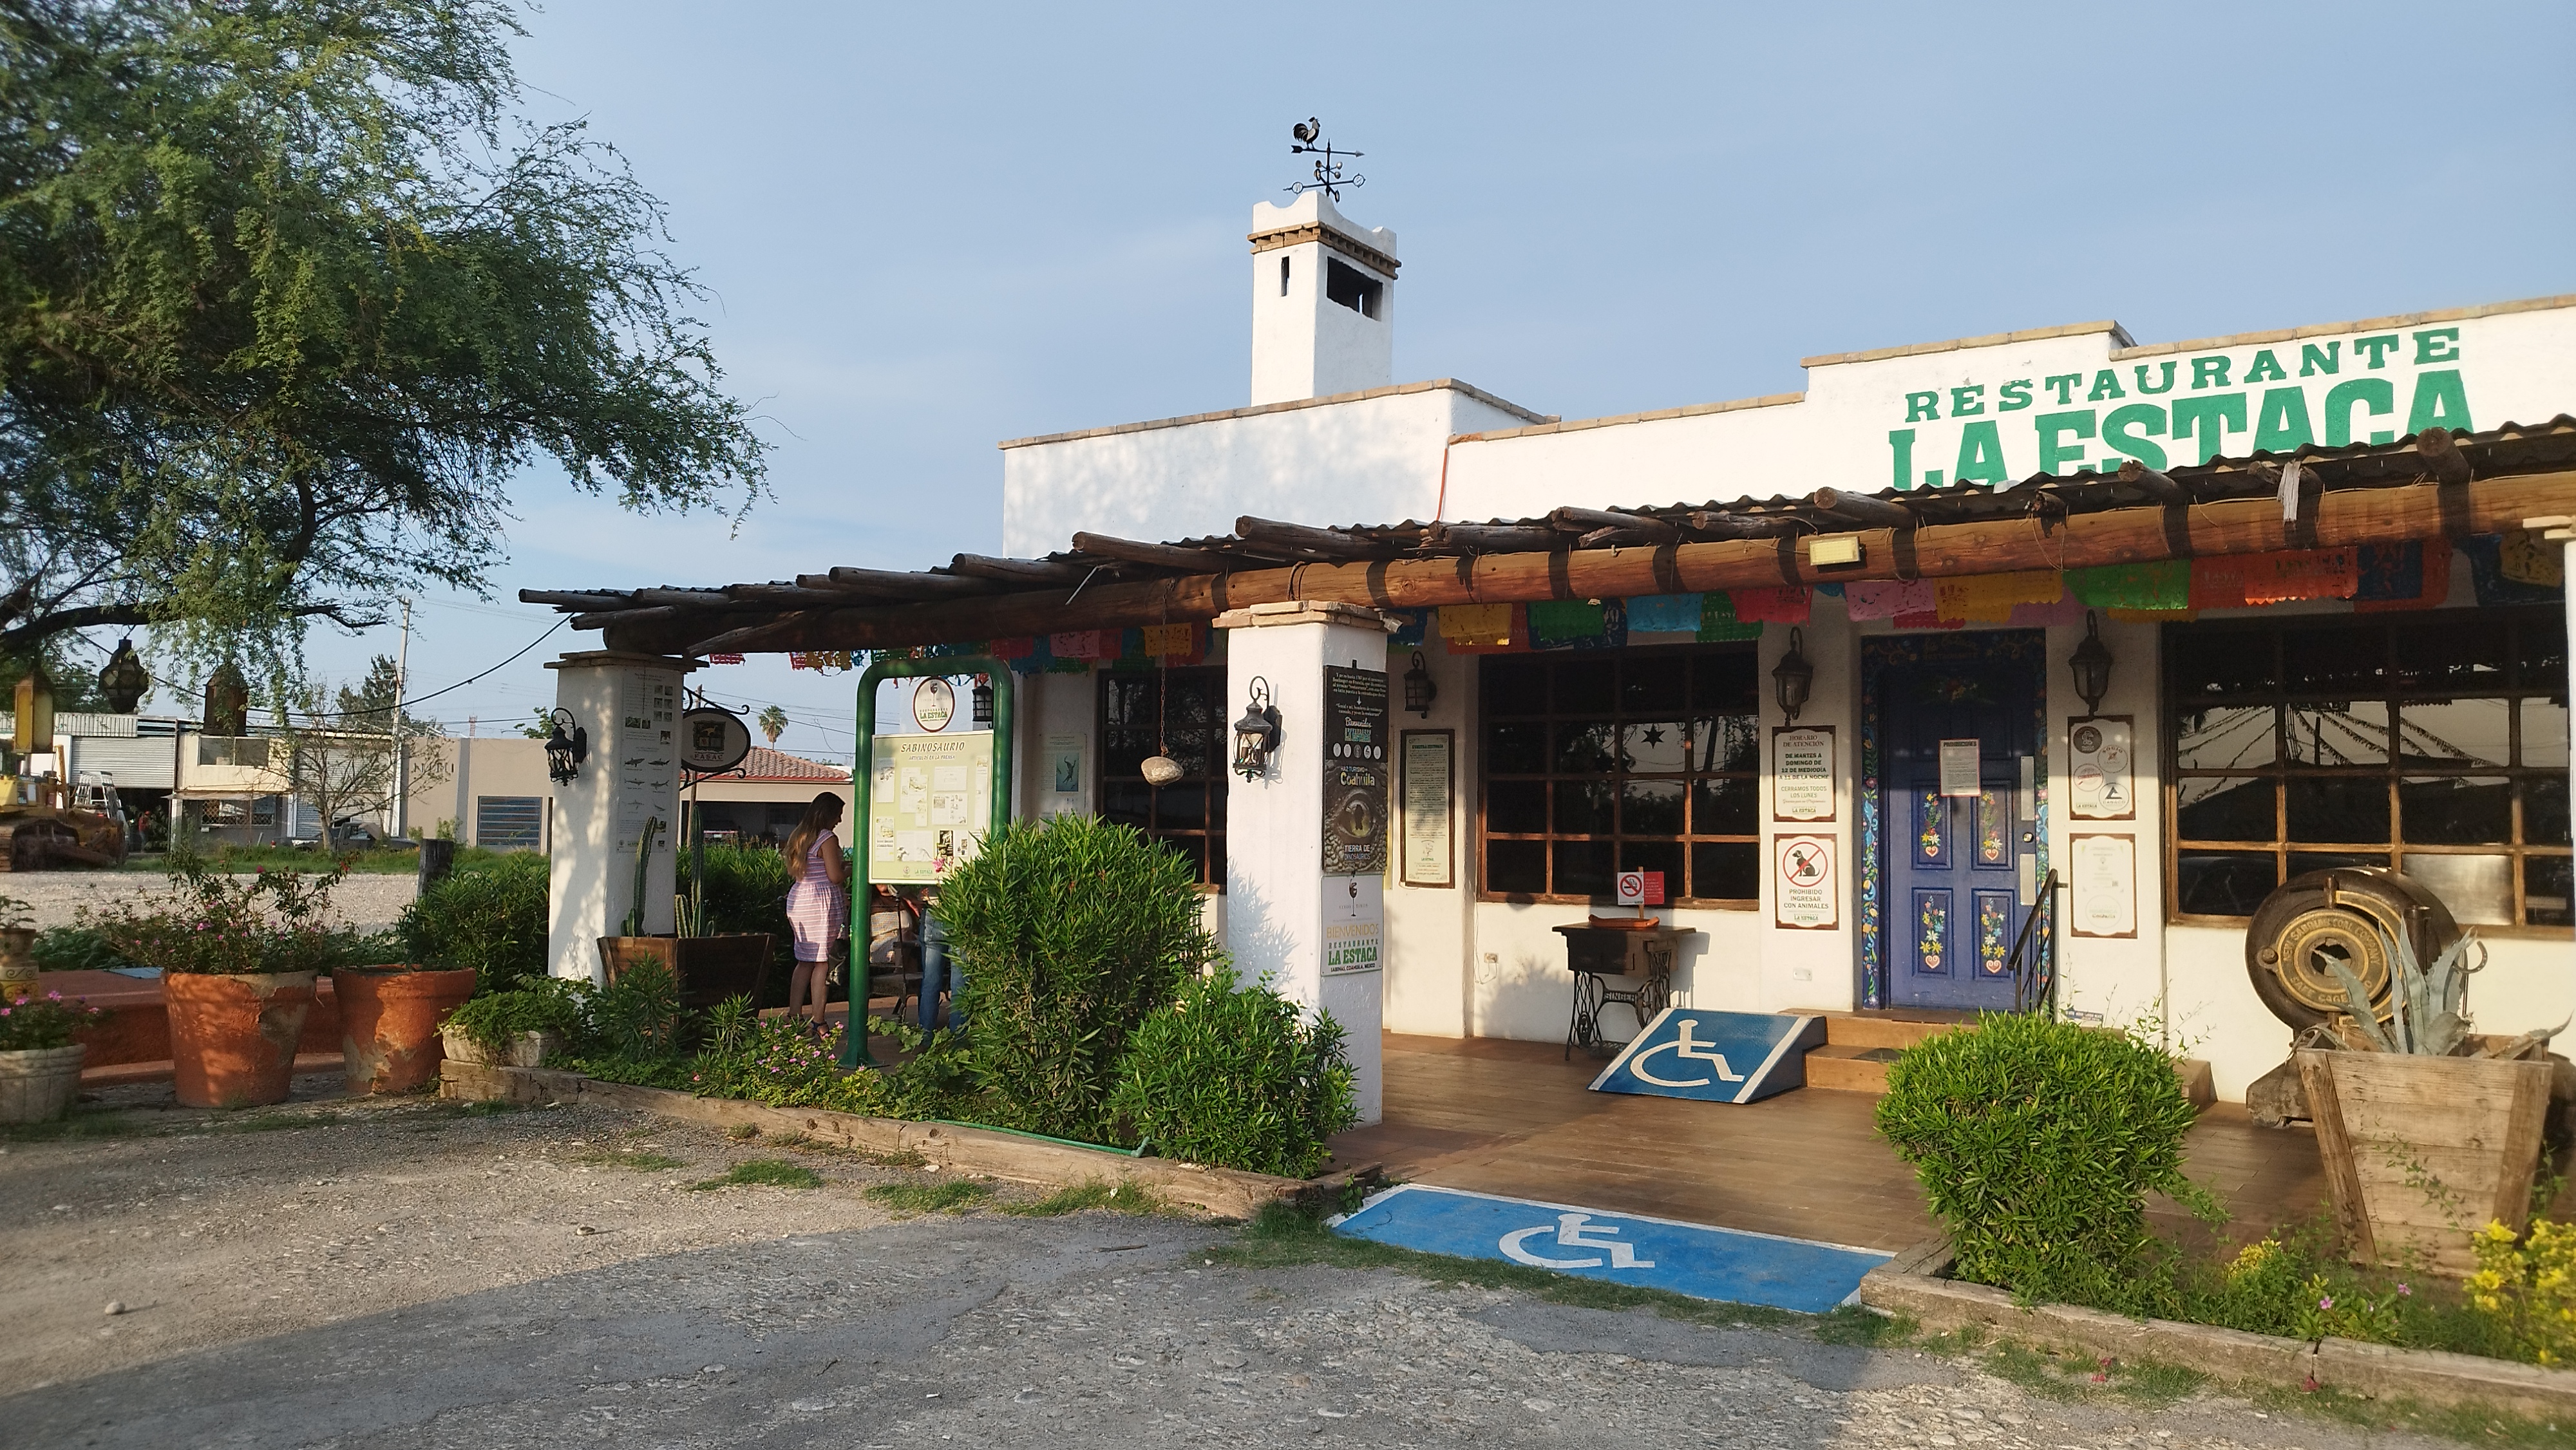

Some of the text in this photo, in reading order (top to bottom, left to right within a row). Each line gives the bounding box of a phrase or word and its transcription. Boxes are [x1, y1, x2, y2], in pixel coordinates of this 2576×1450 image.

[1904, 327, 2460, 422] RESTAURANTE
[1888, 370, 2474, 491] LA ESTACA
[900, 742, 965, 753] SABINOSAURIO
[1340, 772, 1375, 786] Coahuila
[1327, 923, 1379, 939] BIENVENIDOS
[1329, 938, 1379, 949] RESTAURANTE
[2333, 918, 2354, 930] COAL
[2354, 927, 2382, 965] COMPANY
[1328, 946, 1378, 966] LA ESTACA
[1605, 992, 1637, 1004] SINGER
